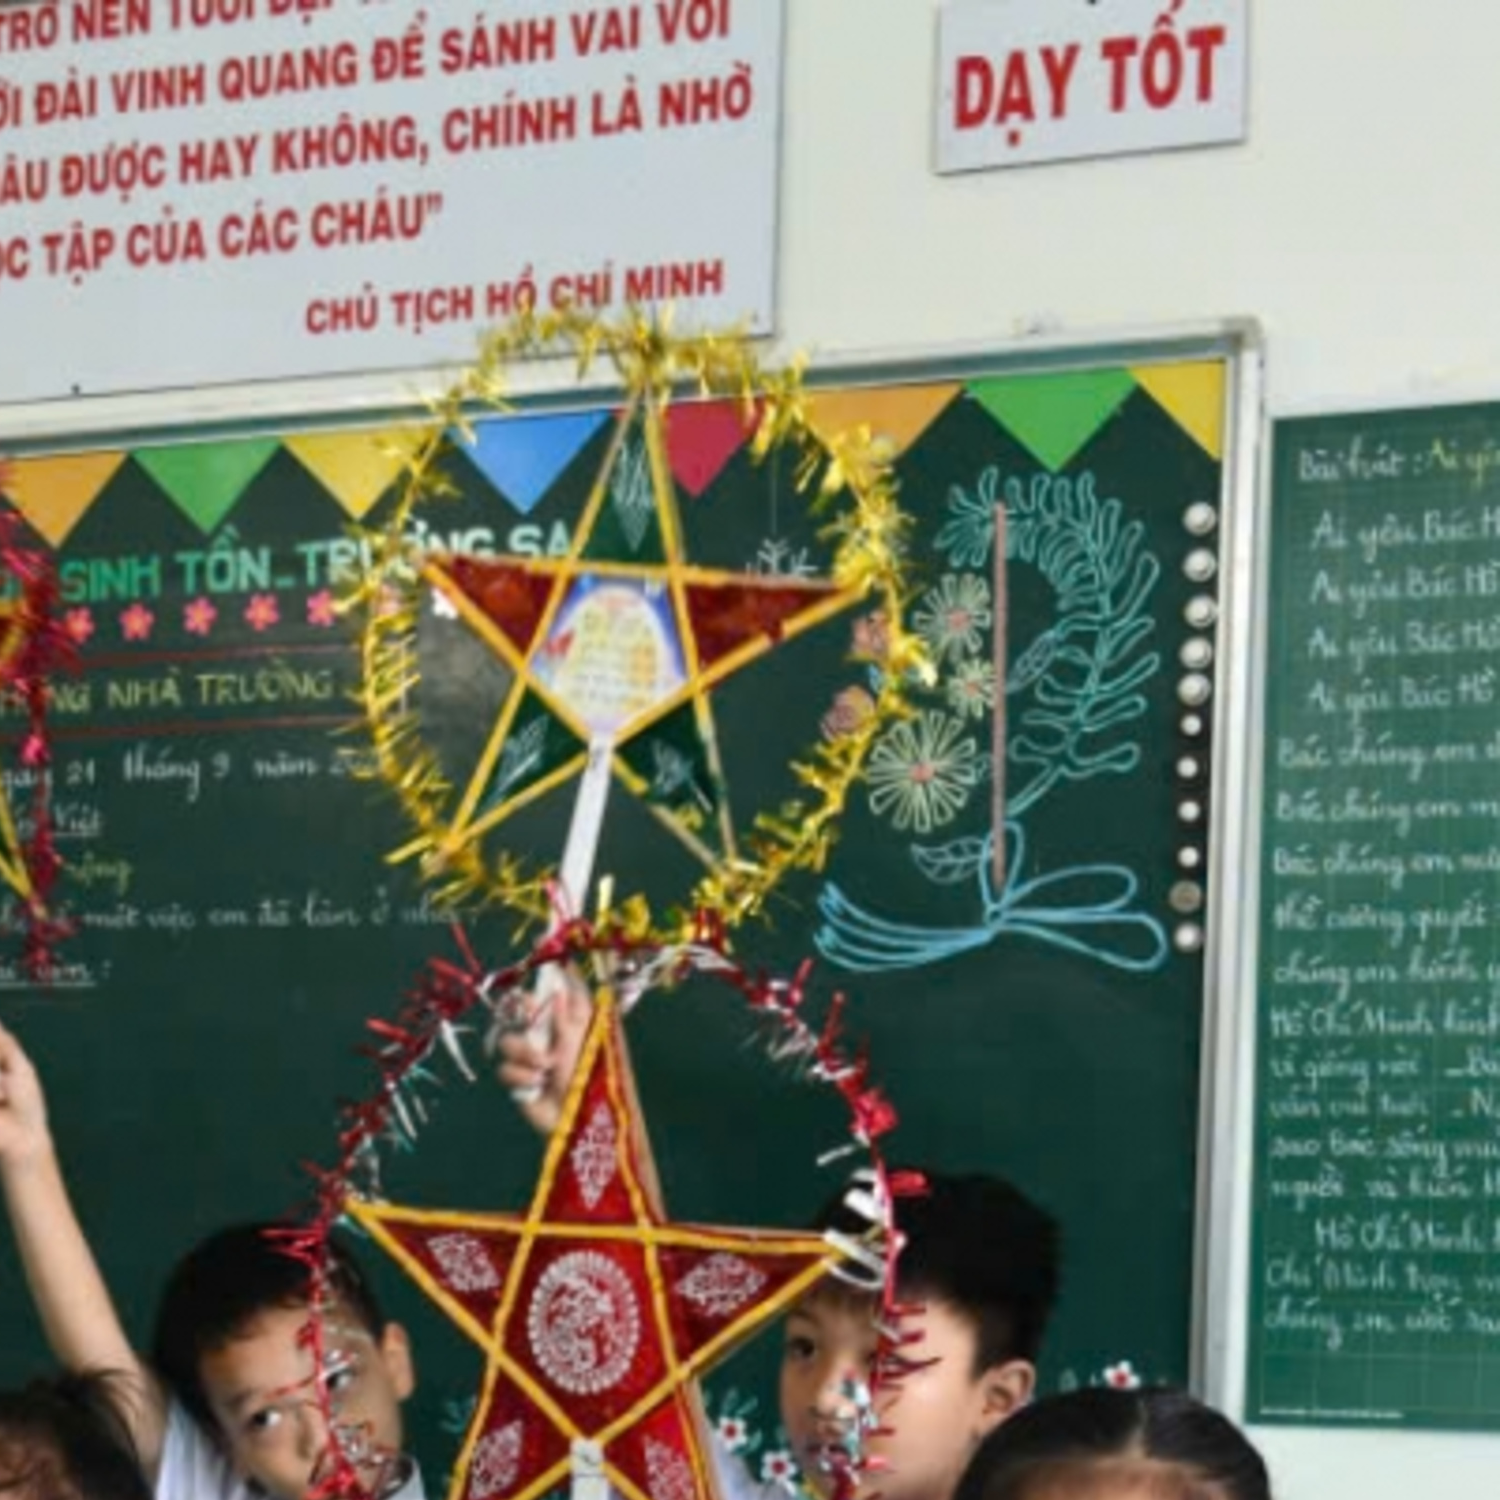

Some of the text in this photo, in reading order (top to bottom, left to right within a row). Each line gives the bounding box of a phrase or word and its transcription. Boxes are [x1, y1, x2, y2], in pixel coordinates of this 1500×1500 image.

[35, 66, 97, 125] ĐÀI
[111, 62, 206, 113] VINH
[218, 41, 358, 103] QUANG
[372, 9, 427, 82] ĐỂ
[440, 12, 555, 74] SÁNH
[570, 5, 640, 57] VAI
[953, 0, 1227, 148] DẠY TỐT
[60, 139, 166, 203] ĐƯỢC
[179, 134, 259, 184] HAY
[272, 111, 429, 174] KHÔNG,
[442, 90, 575, 154] CHÍNH
[590, 73, 642, 136] LÀ
[658, 61, 752, 128] NHỜ
[42, 221, 115, 286] TẬP
[126, 204, 206, 267] CỦA
[218, 198, 299, 260] CÁC
[306, 281, 378, 335] CHỦ
[390, 286, 474, 335] TỊCH
[625, 260, 723, 304] MINH
[60, 553, 161, 602] SINH
[106, 667, 181, 708] NHÀ
